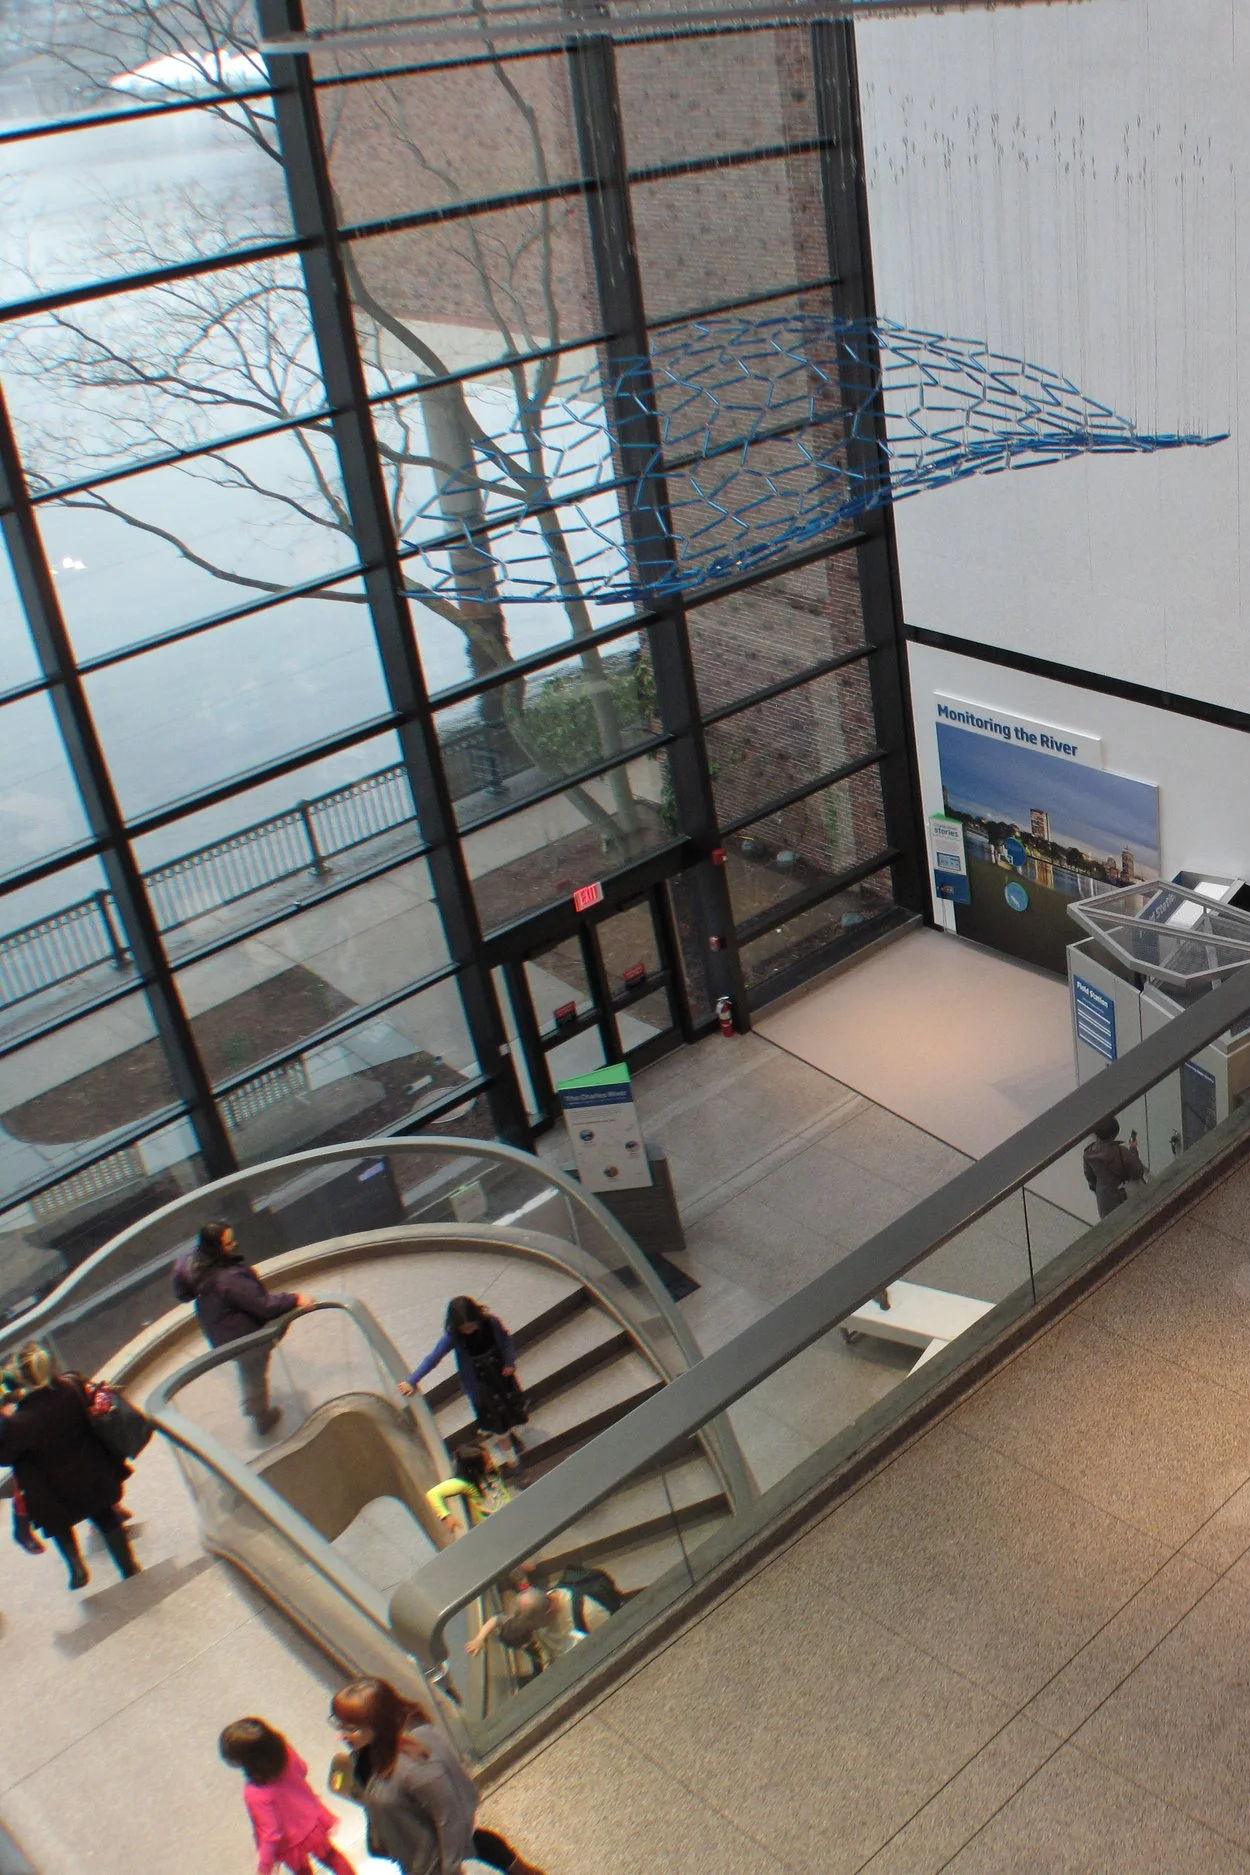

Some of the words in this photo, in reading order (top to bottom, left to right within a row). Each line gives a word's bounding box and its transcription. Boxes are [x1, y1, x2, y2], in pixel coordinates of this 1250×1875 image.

[937, 703, 1011, 740] Monitoring
[1014, 727, 1038, 745] the
[1040, 733, 1078, 757] River
[934, 827, 959, 838] stories
[579, 886, 597, 905] EXIT
[1076, 981, 1090, 995] Field
[1089, 990, 1109, 1008] Station
